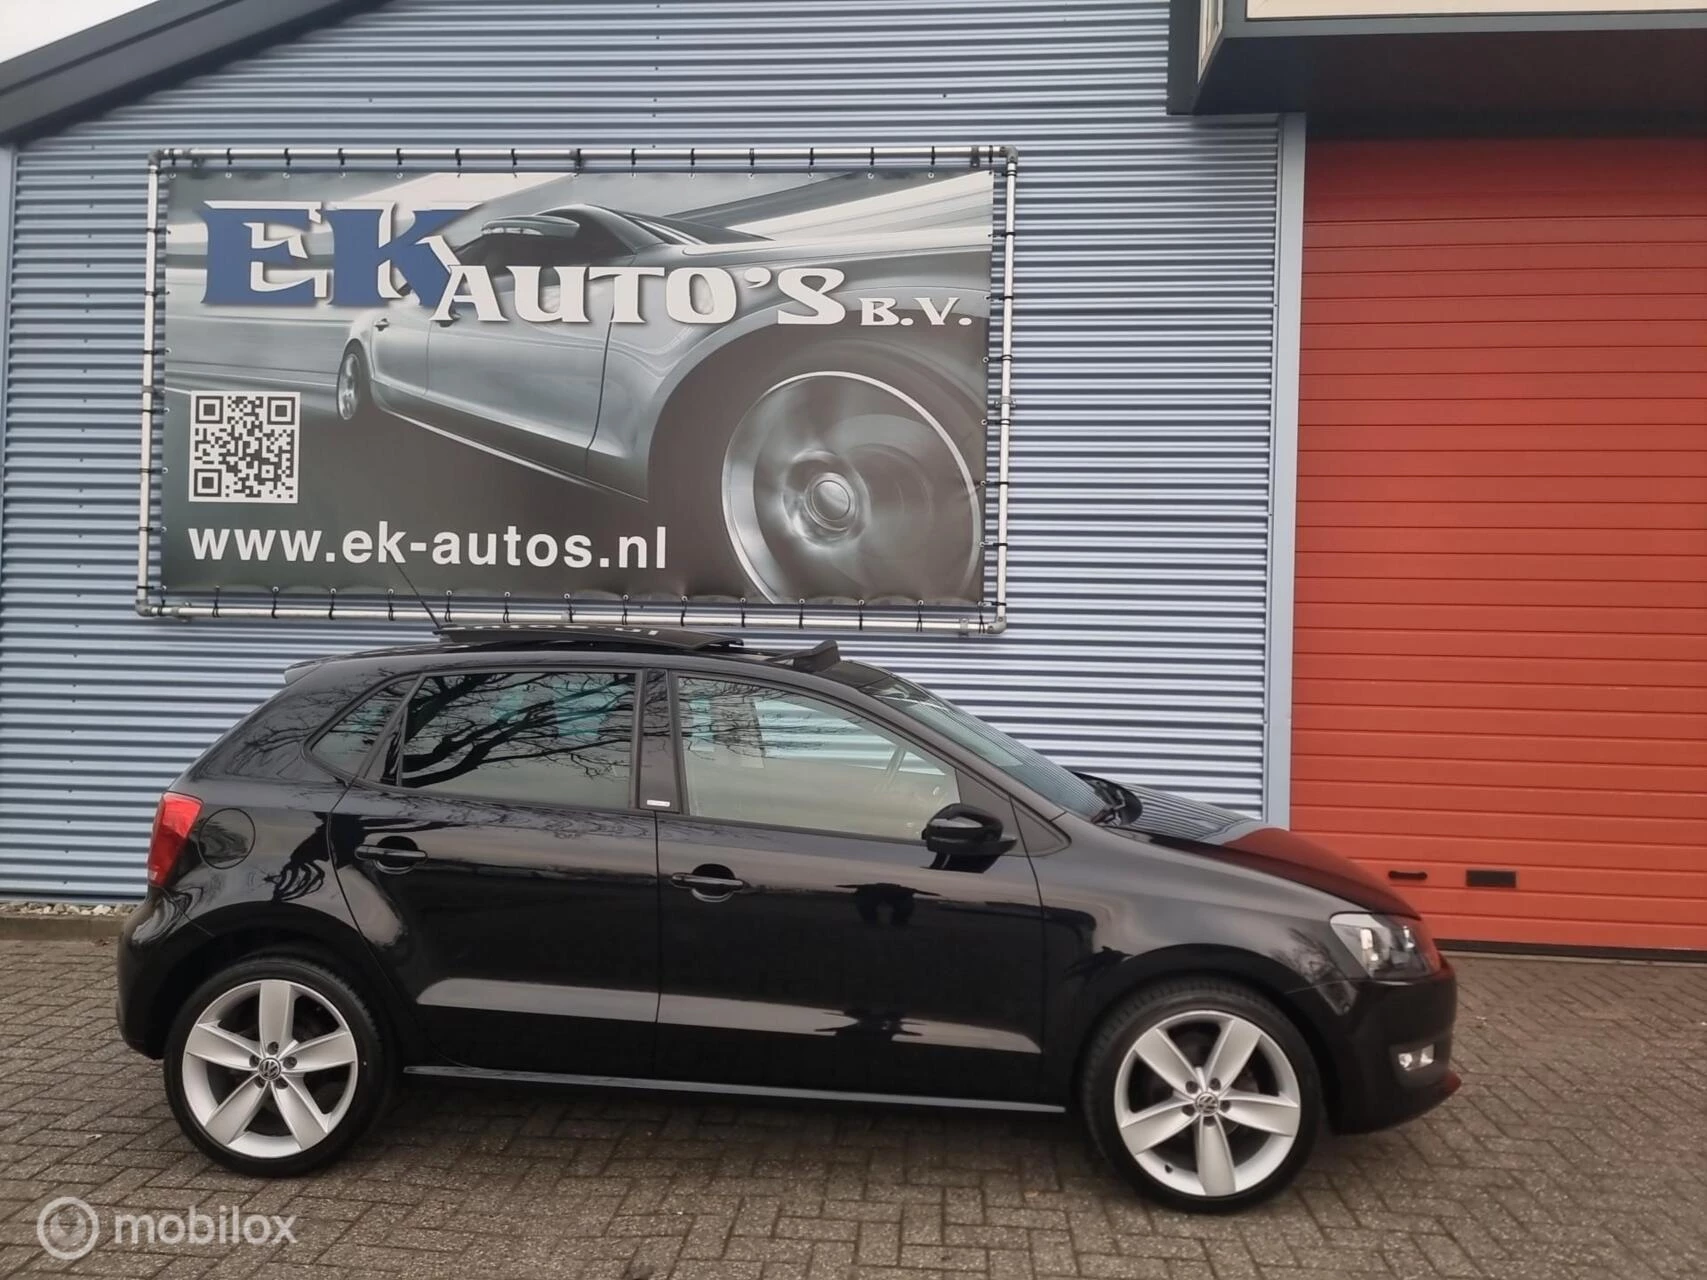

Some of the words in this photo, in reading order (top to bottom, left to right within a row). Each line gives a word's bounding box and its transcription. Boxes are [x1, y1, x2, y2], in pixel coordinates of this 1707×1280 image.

[201, 200, 483, 307] EK
[430, 265, 846, 325] AUTO'S
[860, 297, 972, 326] B.V.
[188, 520, 666, 569] www.ek-autos.nl
